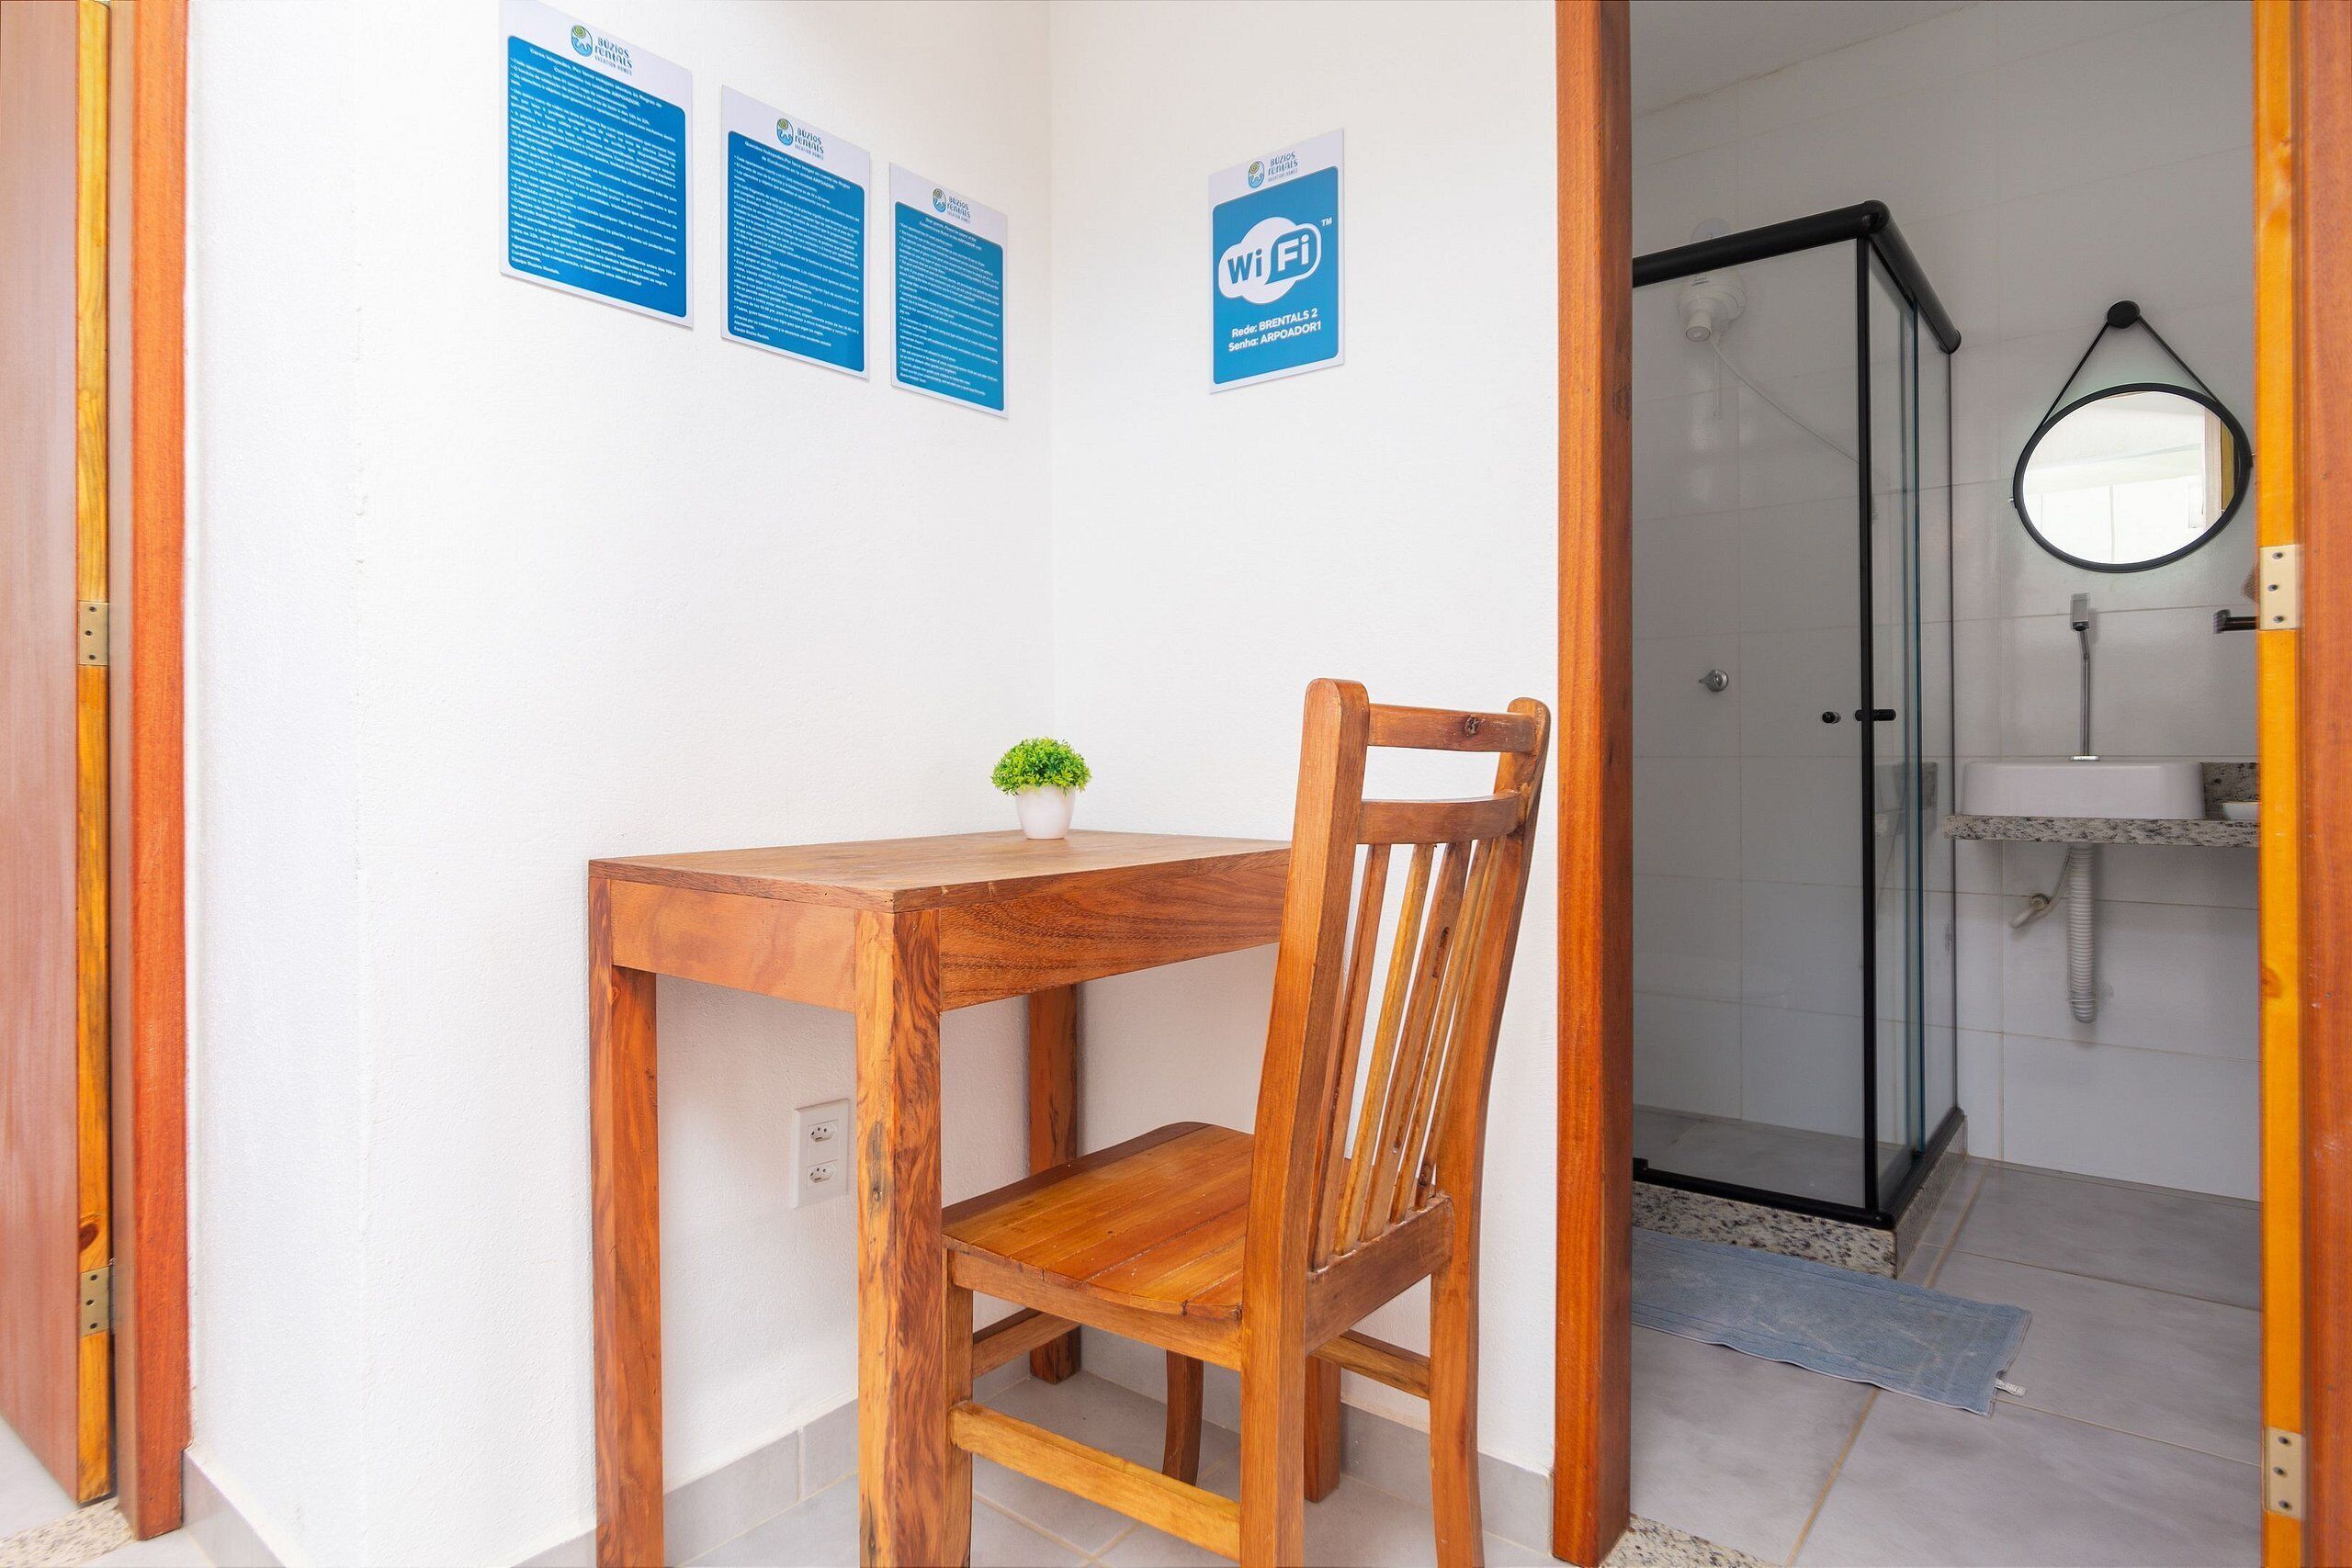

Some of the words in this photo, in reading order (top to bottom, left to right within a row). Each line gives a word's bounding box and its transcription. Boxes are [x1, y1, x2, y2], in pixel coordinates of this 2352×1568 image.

[1228, 337, 1260, 352] Senha:
[1260, 320, 1323, 344] ARPOADOR1
[1231, 323, 1258, 338] Rede:
[1259, 310, 1310, 332] BRENTALS
[1311, 307, 1319, 319] 2
